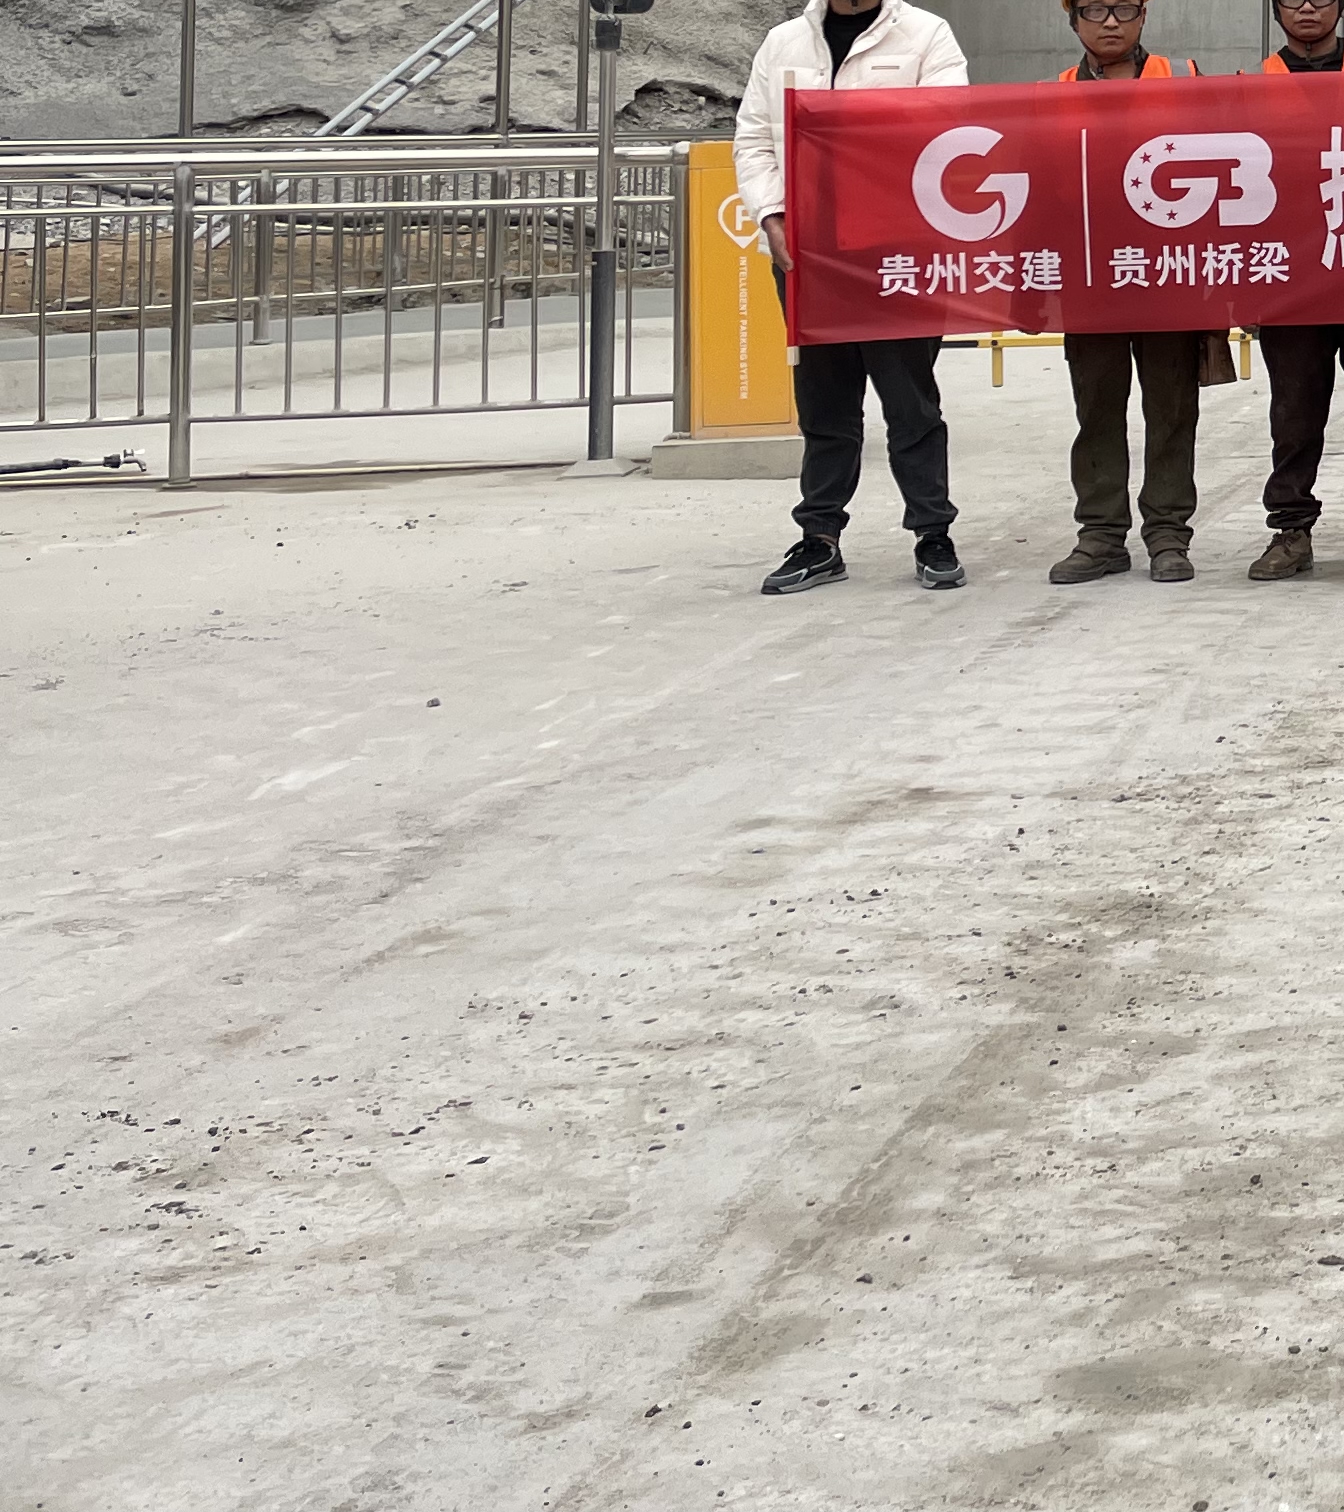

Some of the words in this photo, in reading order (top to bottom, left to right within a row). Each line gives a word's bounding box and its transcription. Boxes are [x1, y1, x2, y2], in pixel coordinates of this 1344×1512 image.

[739, 256, 747, 316] INTELLIGENT
[878, 248, 1063, 297] 贵州交建
[1108, 240, 1290, 289] 贵州桥梁
[739, 319, 748, 361] PARKING
[739, 362, 749, 400] SYSTEM
